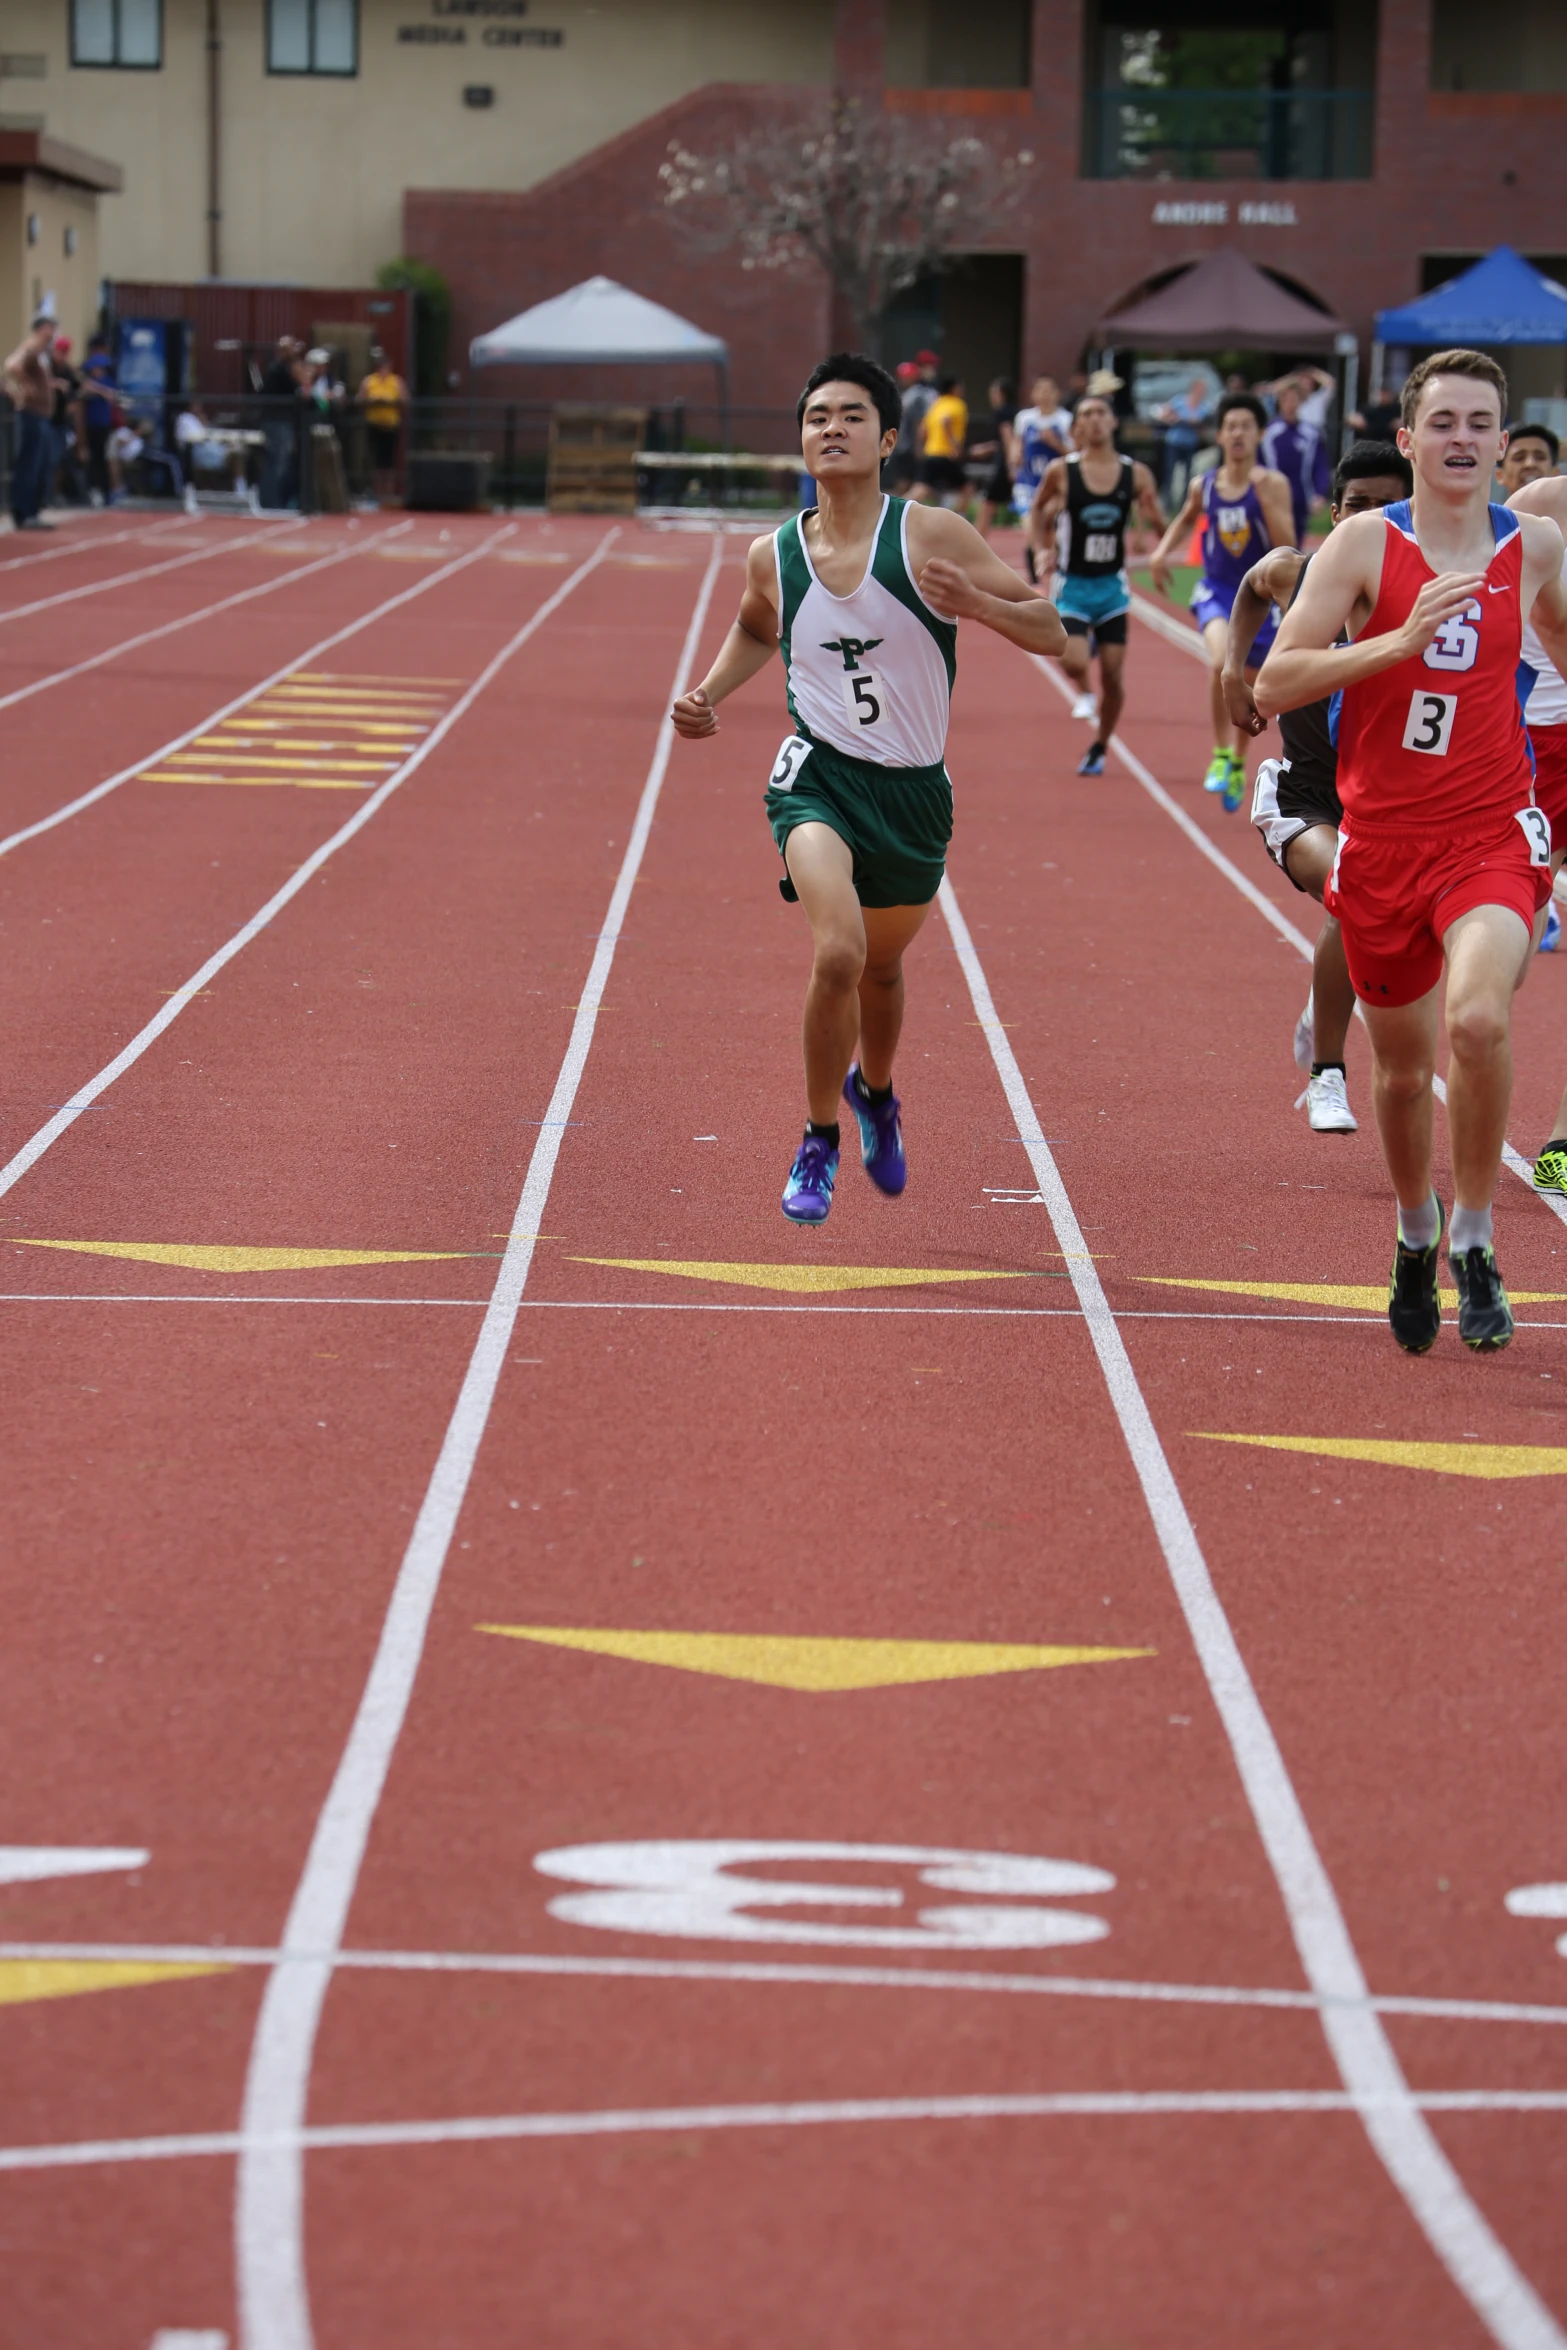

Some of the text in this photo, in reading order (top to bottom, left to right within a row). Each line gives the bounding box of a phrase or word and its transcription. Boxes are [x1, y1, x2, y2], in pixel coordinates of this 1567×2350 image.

[397, 25, 565, 48] MEDIA CENTER
[840, 638, 865, 671] P
[852, 675, 881, 726] 5
[1412, 696, 1447, 750] 3
[771, 739, 805, 784] 5
[1526, 810, 1550, 863] 3
[532, 1838, 1118, 1950] 3
